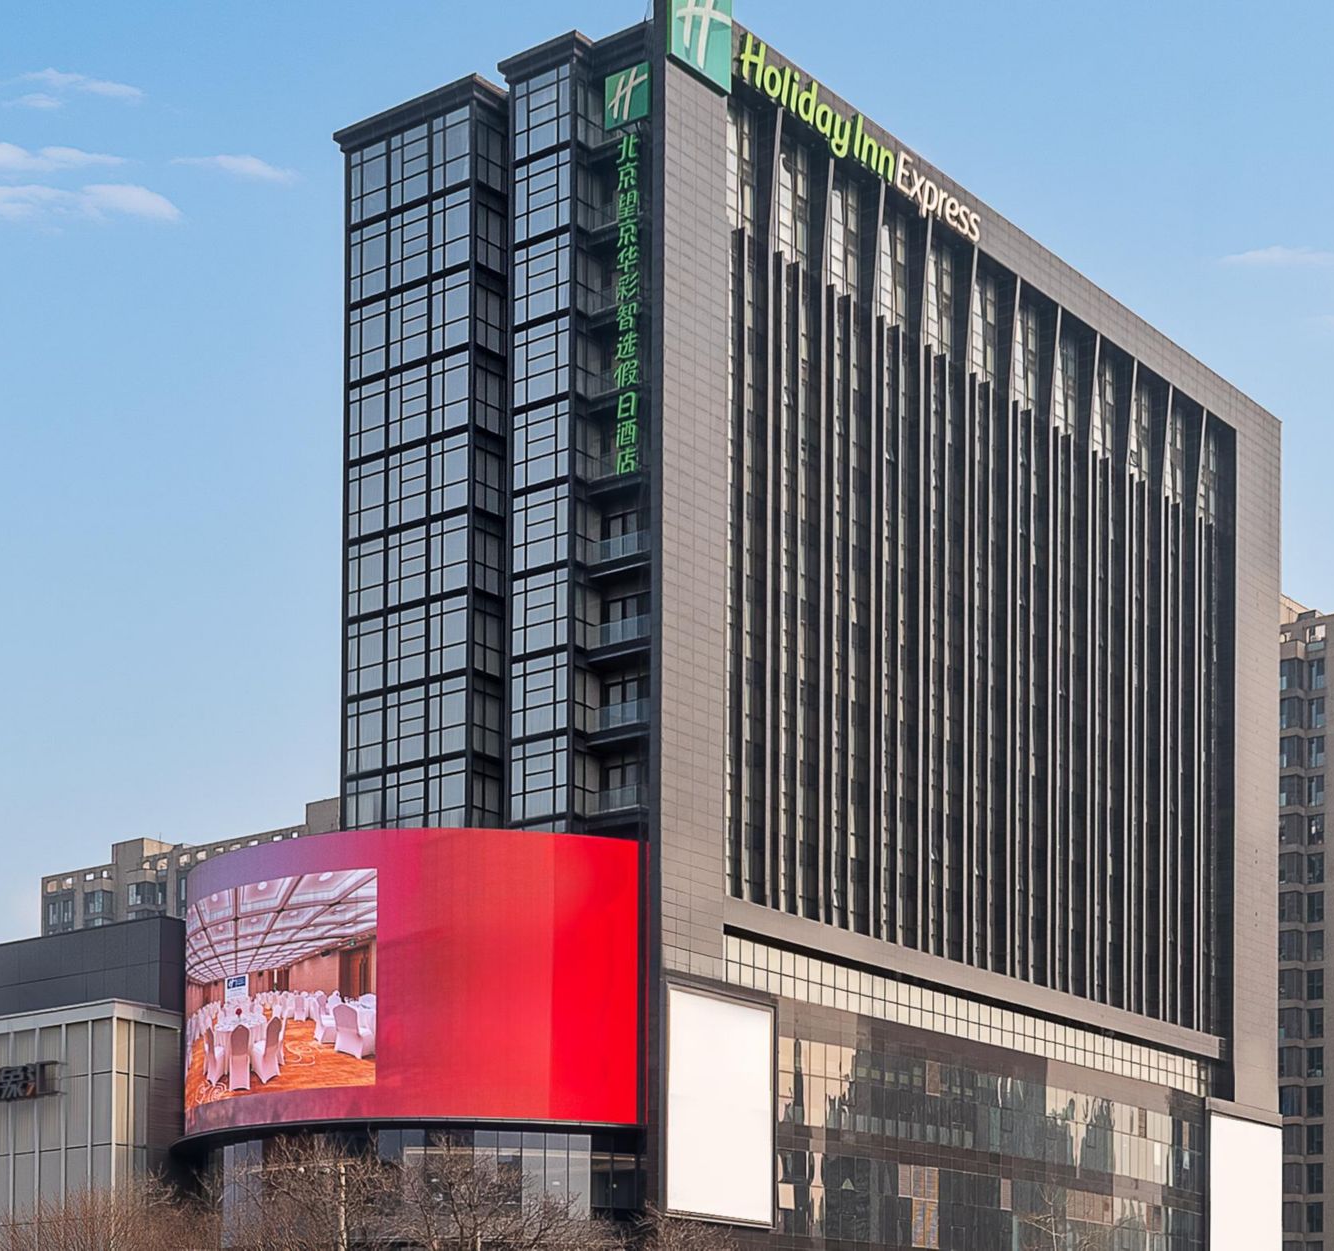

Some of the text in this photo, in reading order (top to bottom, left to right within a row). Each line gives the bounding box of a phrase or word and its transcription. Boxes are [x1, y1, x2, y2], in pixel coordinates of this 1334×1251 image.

[740, 33, 980, 242] Holiday Inn Express
[615, 135, 639, 475] 北京望京华彩智选假日酒店
